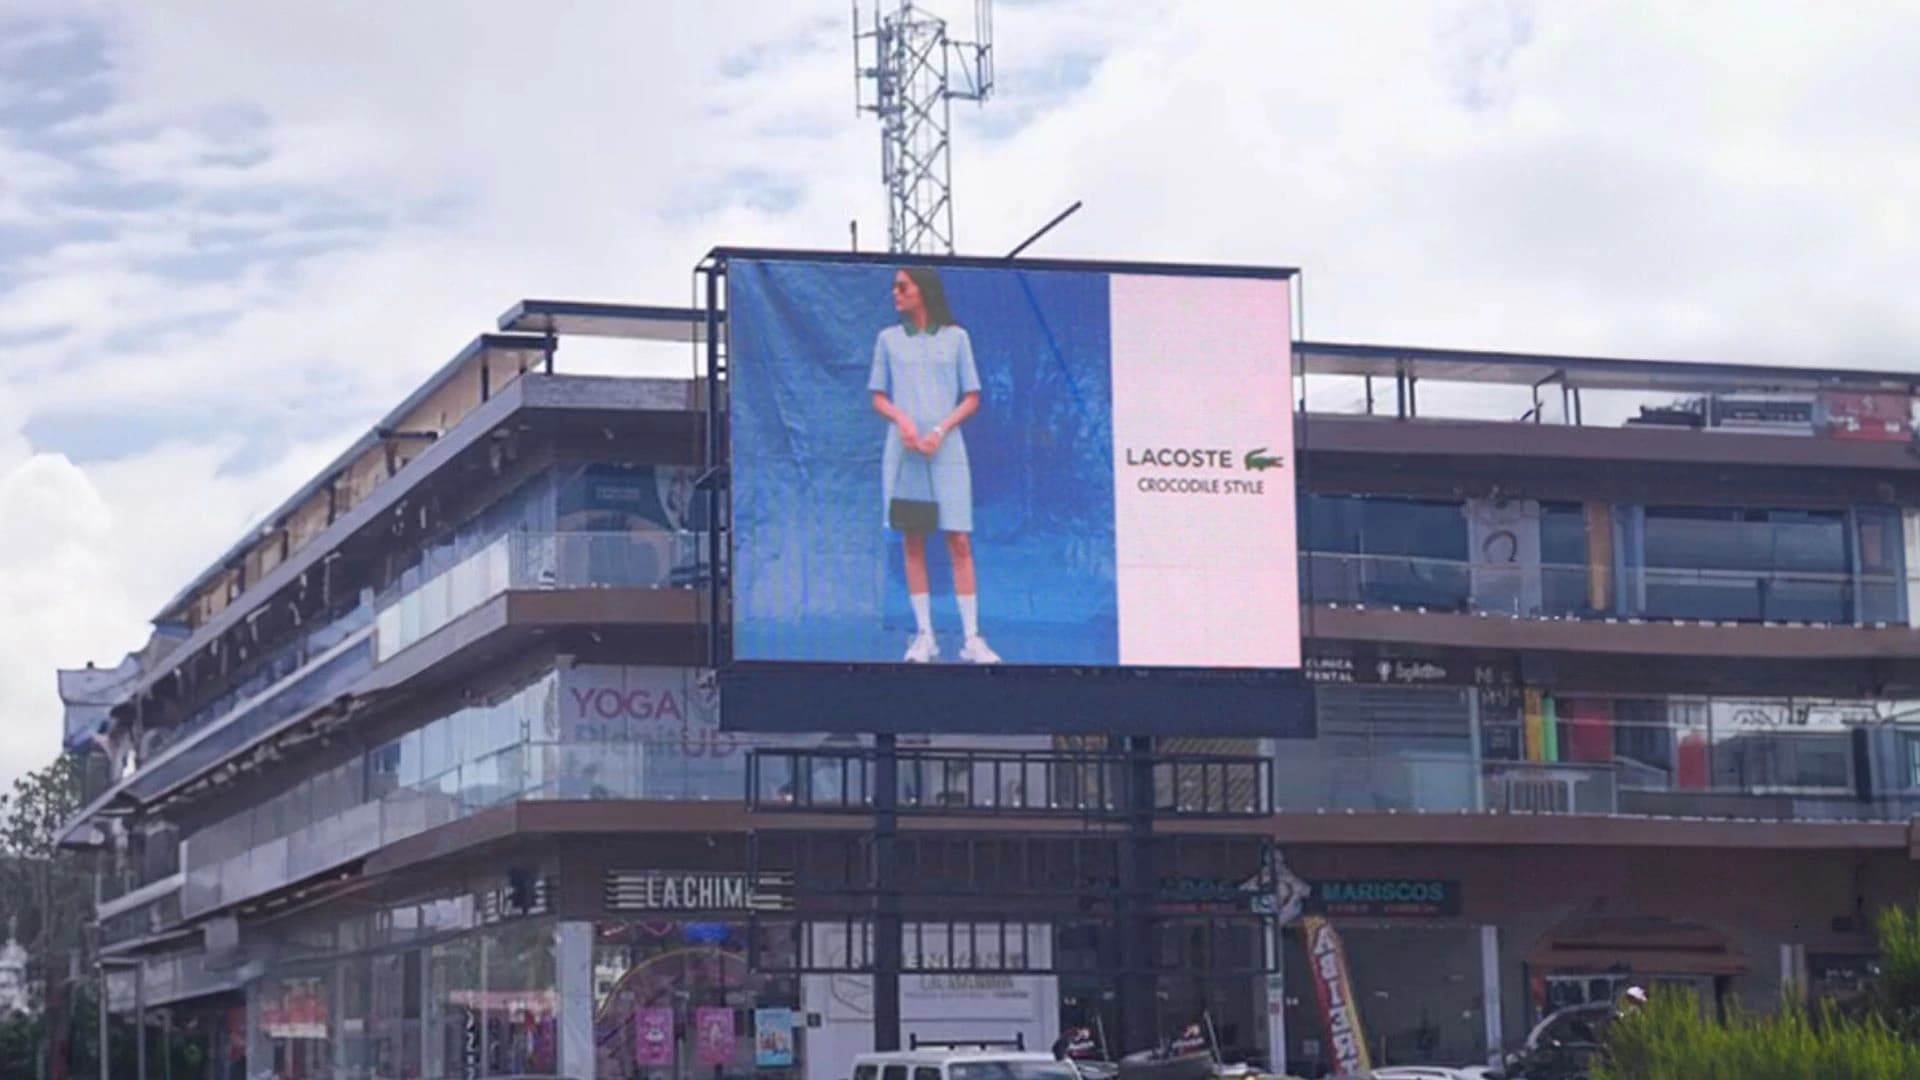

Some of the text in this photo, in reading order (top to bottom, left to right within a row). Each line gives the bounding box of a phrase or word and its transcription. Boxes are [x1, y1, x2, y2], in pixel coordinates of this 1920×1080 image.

[1126, 448, 1233, 468] LACOSTE
[1137, 477, 1264, 495] CROCODILE STYLE
[570, 687, 681, 721] YOGA
[1321, 881, 1445, 901] MARISCOS
